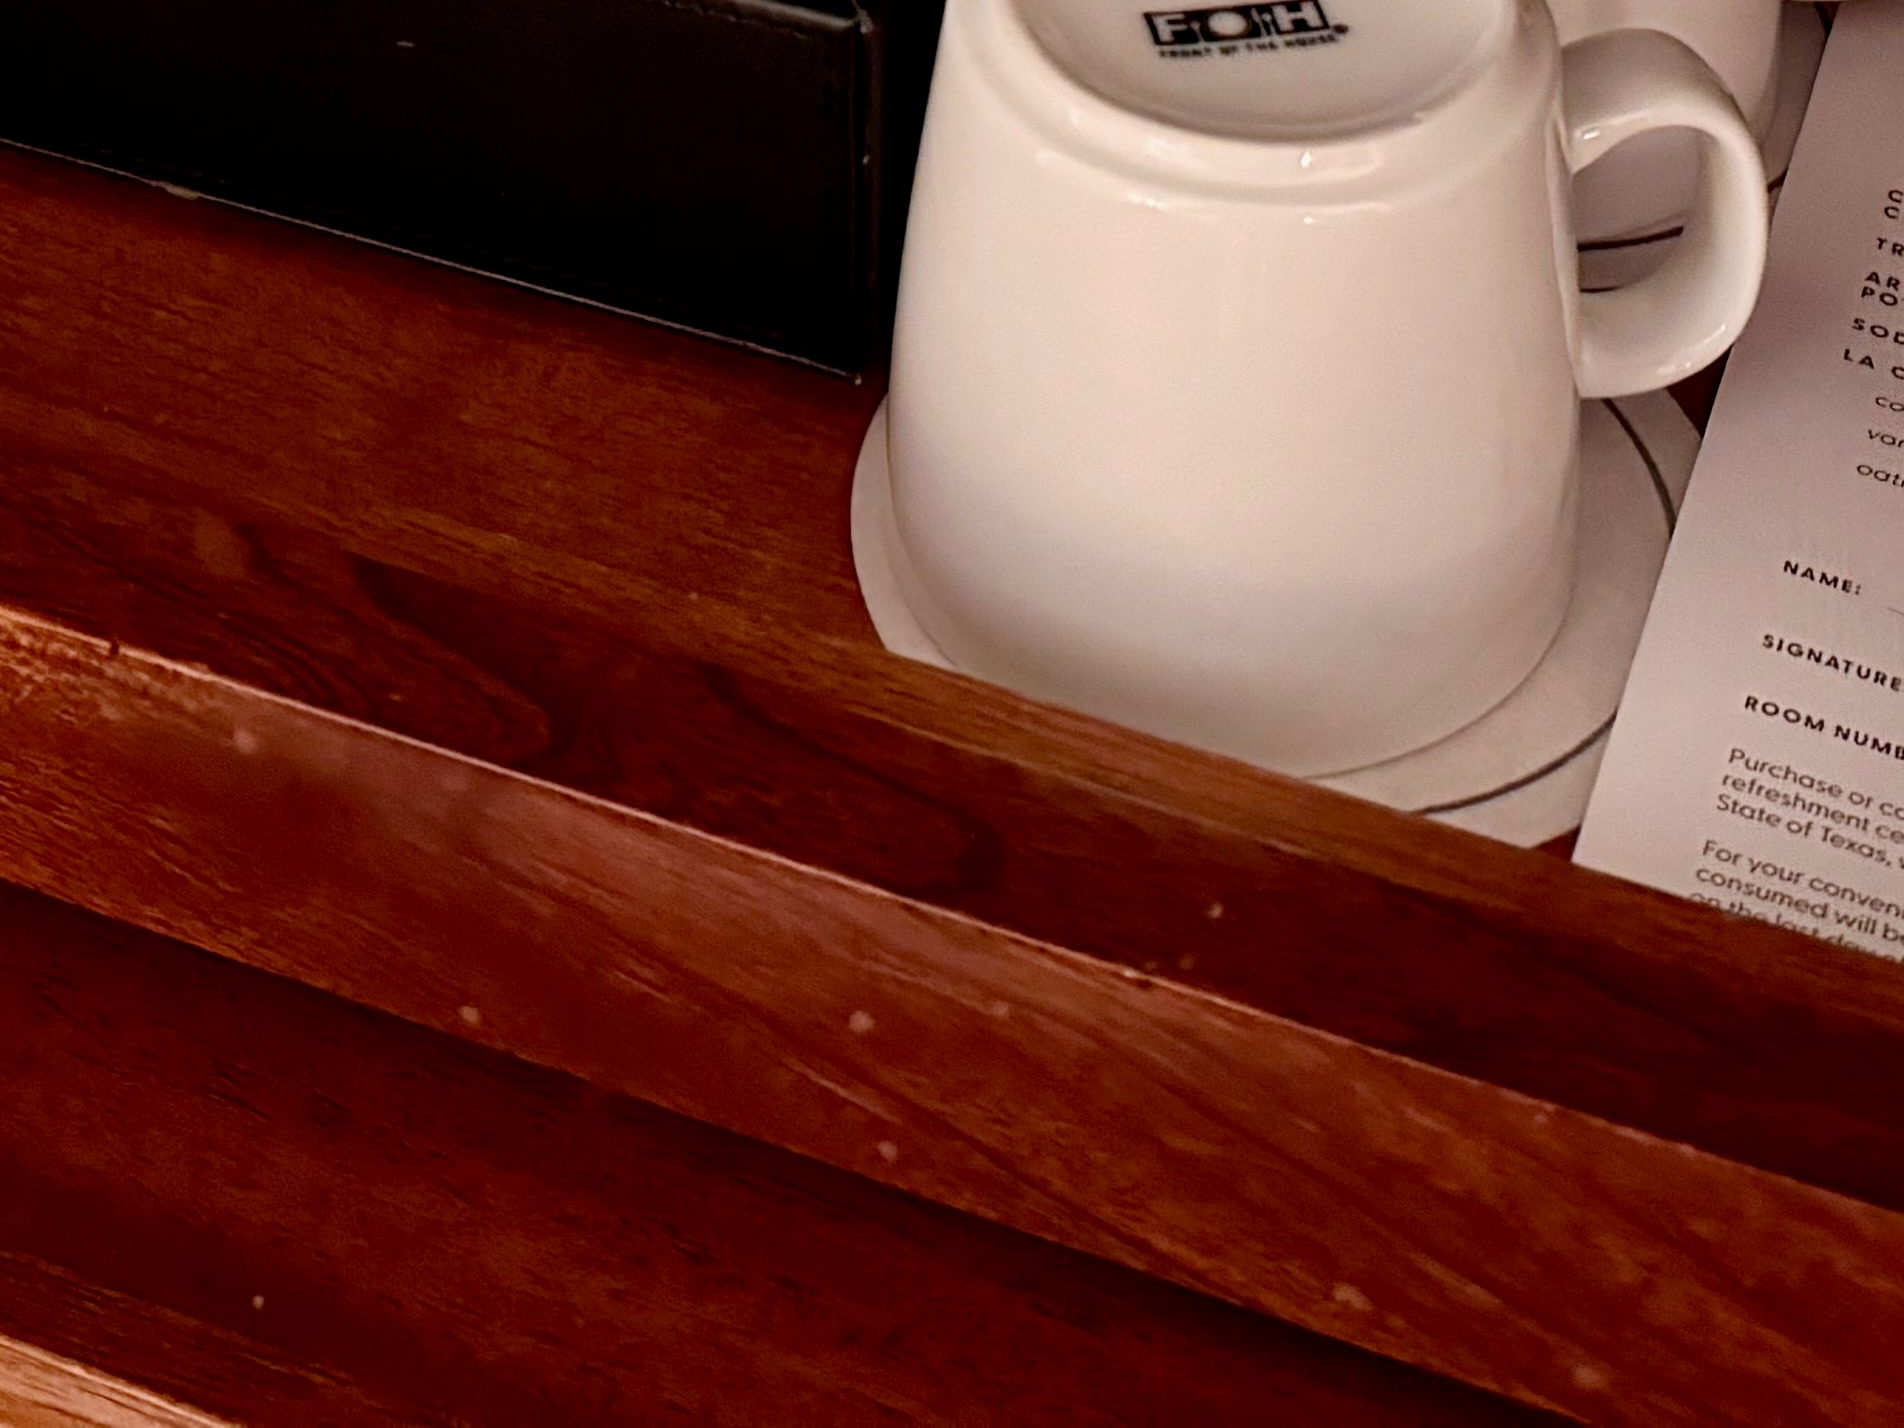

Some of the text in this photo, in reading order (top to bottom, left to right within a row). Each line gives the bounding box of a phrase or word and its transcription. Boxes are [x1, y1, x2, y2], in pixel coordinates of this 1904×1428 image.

[1843, 348, 1874, 370] LA
[1783, 560, 1861, 596] NAME:
[1744, 695, 1825, 732] ROOM
[1716, 793, 1781, 828] State
[1786, 818, 1812, 838] of
[1820, 826, 1892, 867] Texas,
